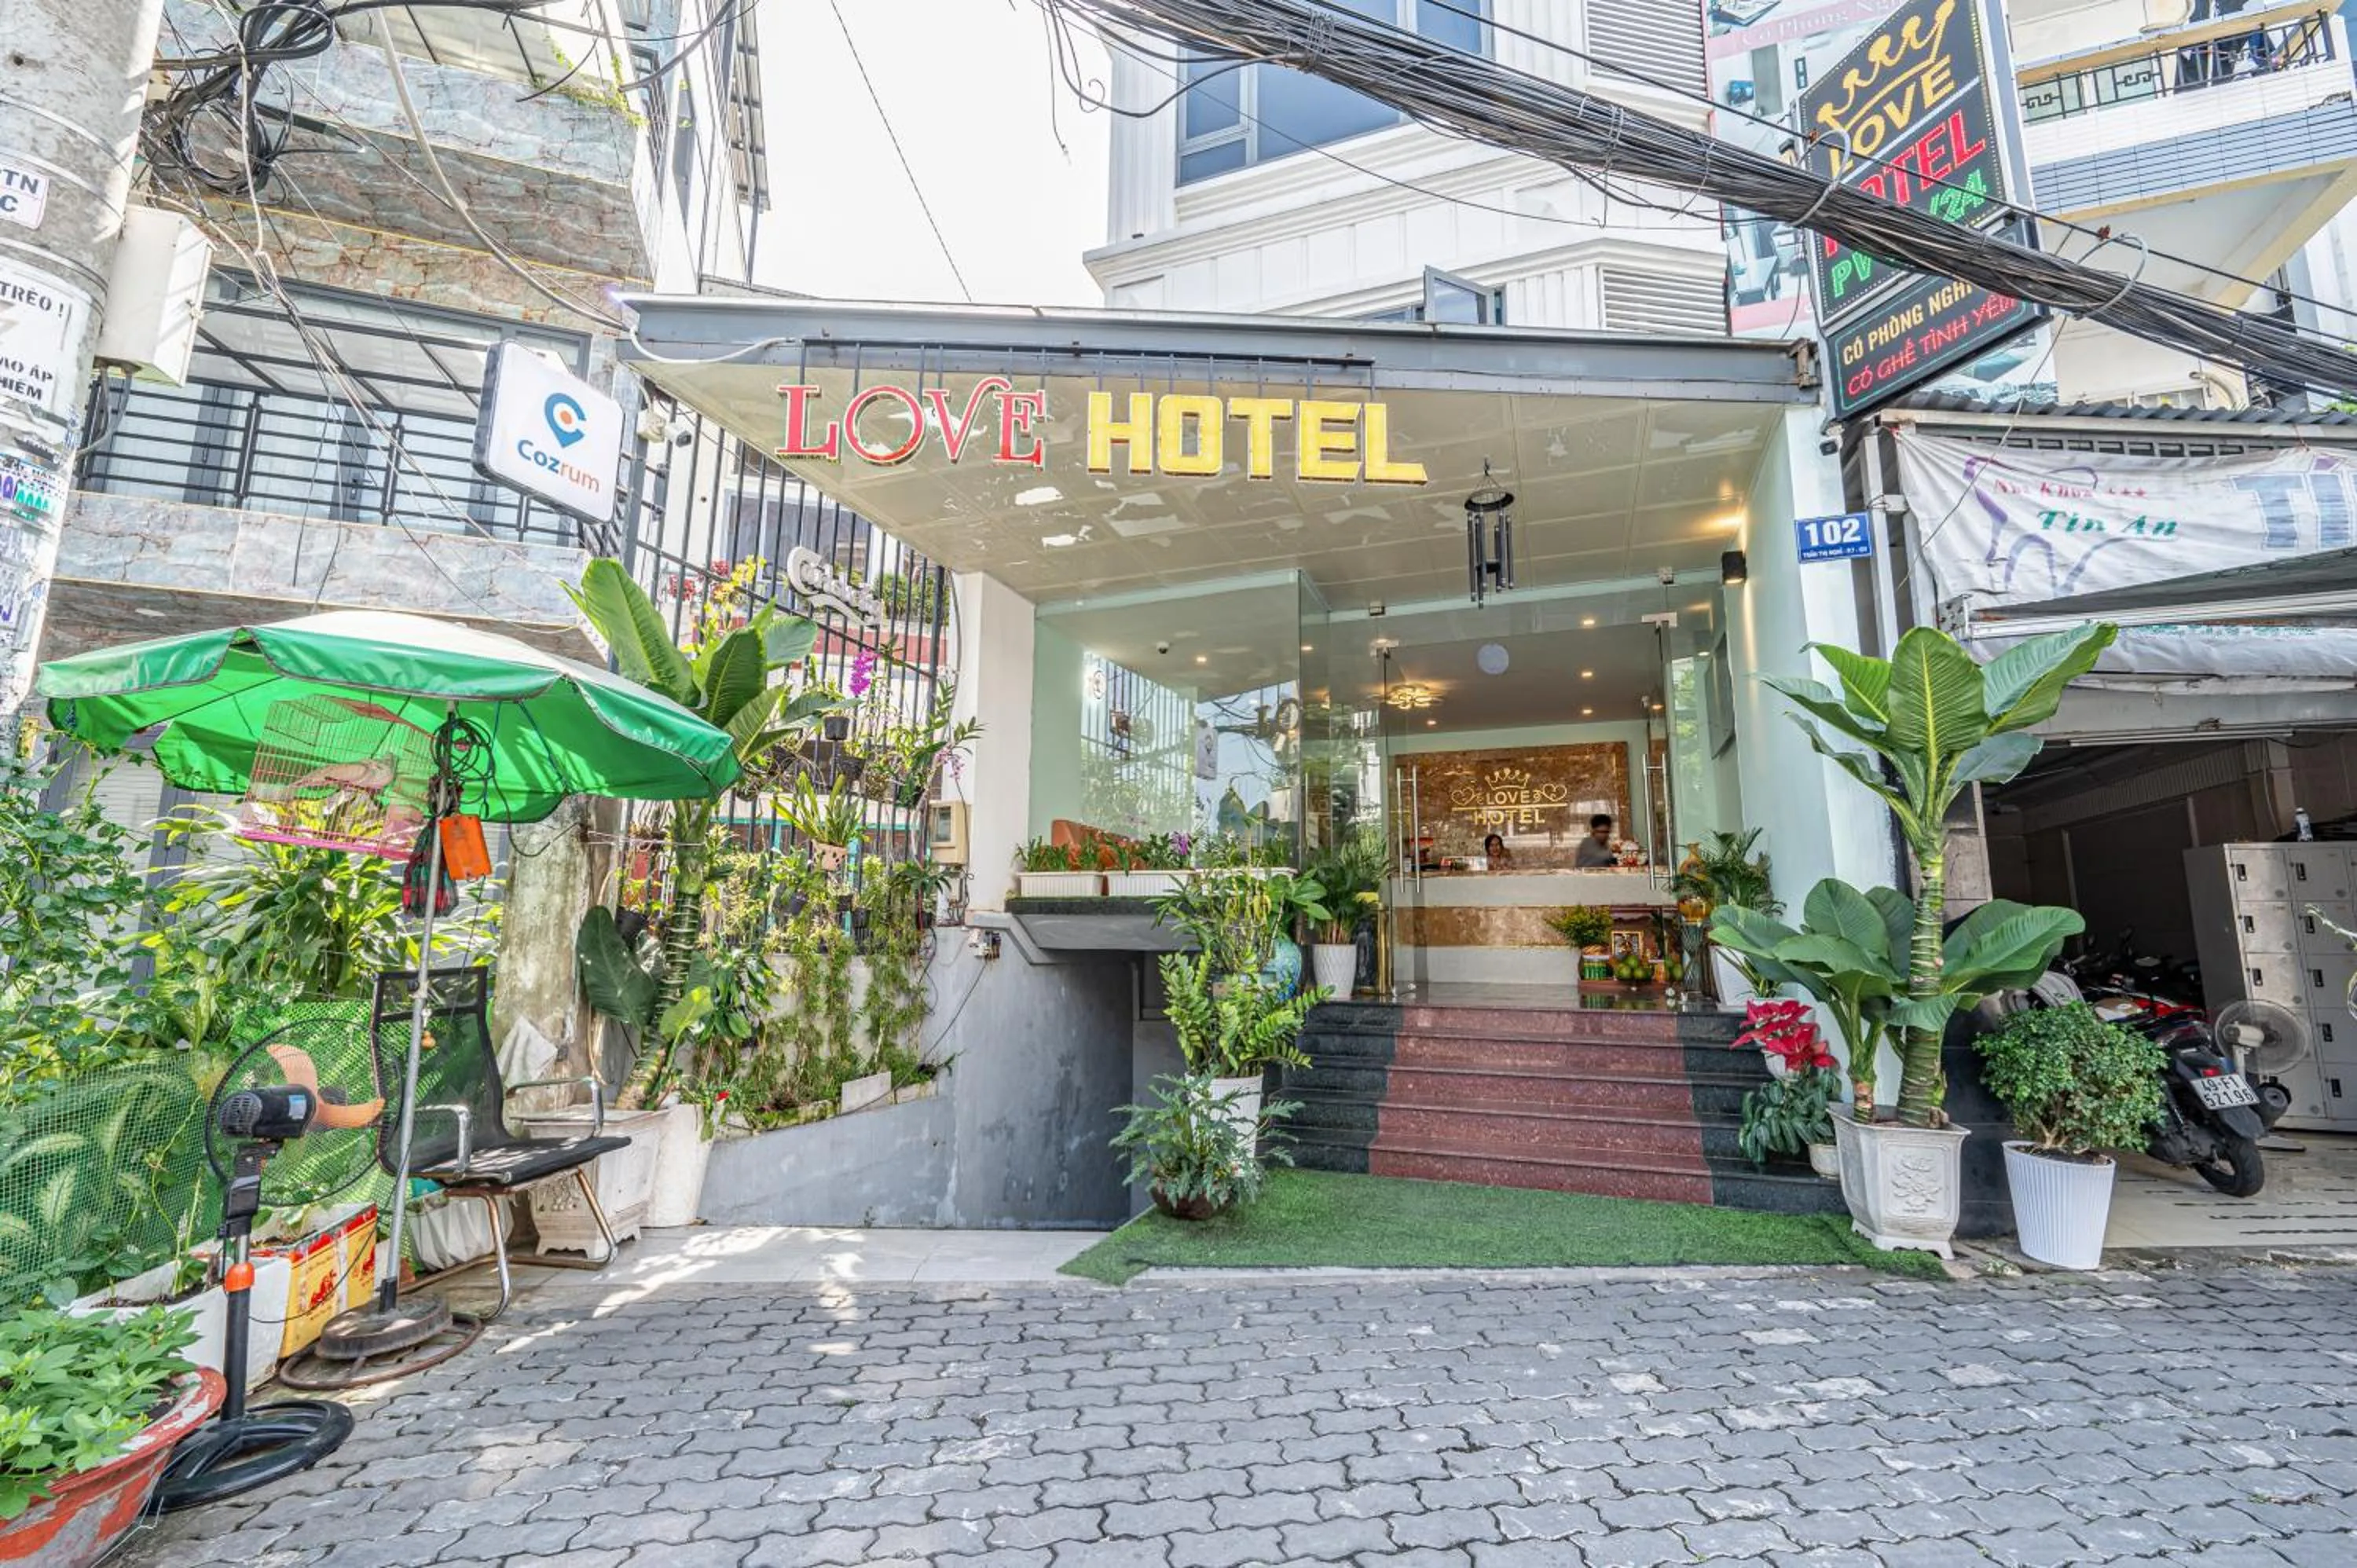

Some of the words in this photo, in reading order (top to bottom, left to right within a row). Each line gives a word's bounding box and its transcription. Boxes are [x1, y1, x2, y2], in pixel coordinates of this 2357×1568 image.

[1829, 53, 1956, 179] LOVE
[0, 169, 38, 194] TN
[1868, 303, 1924, 352] PHÒNG
[775, 376, 1046, 470] LOVE
[1087, 391, 1428, 485] HOTEL
[1805, 518, 1861, 547] 102
[1486, 789, 1530, 806] LOVE
[1473, 808, 1546, 826] HOTEL
